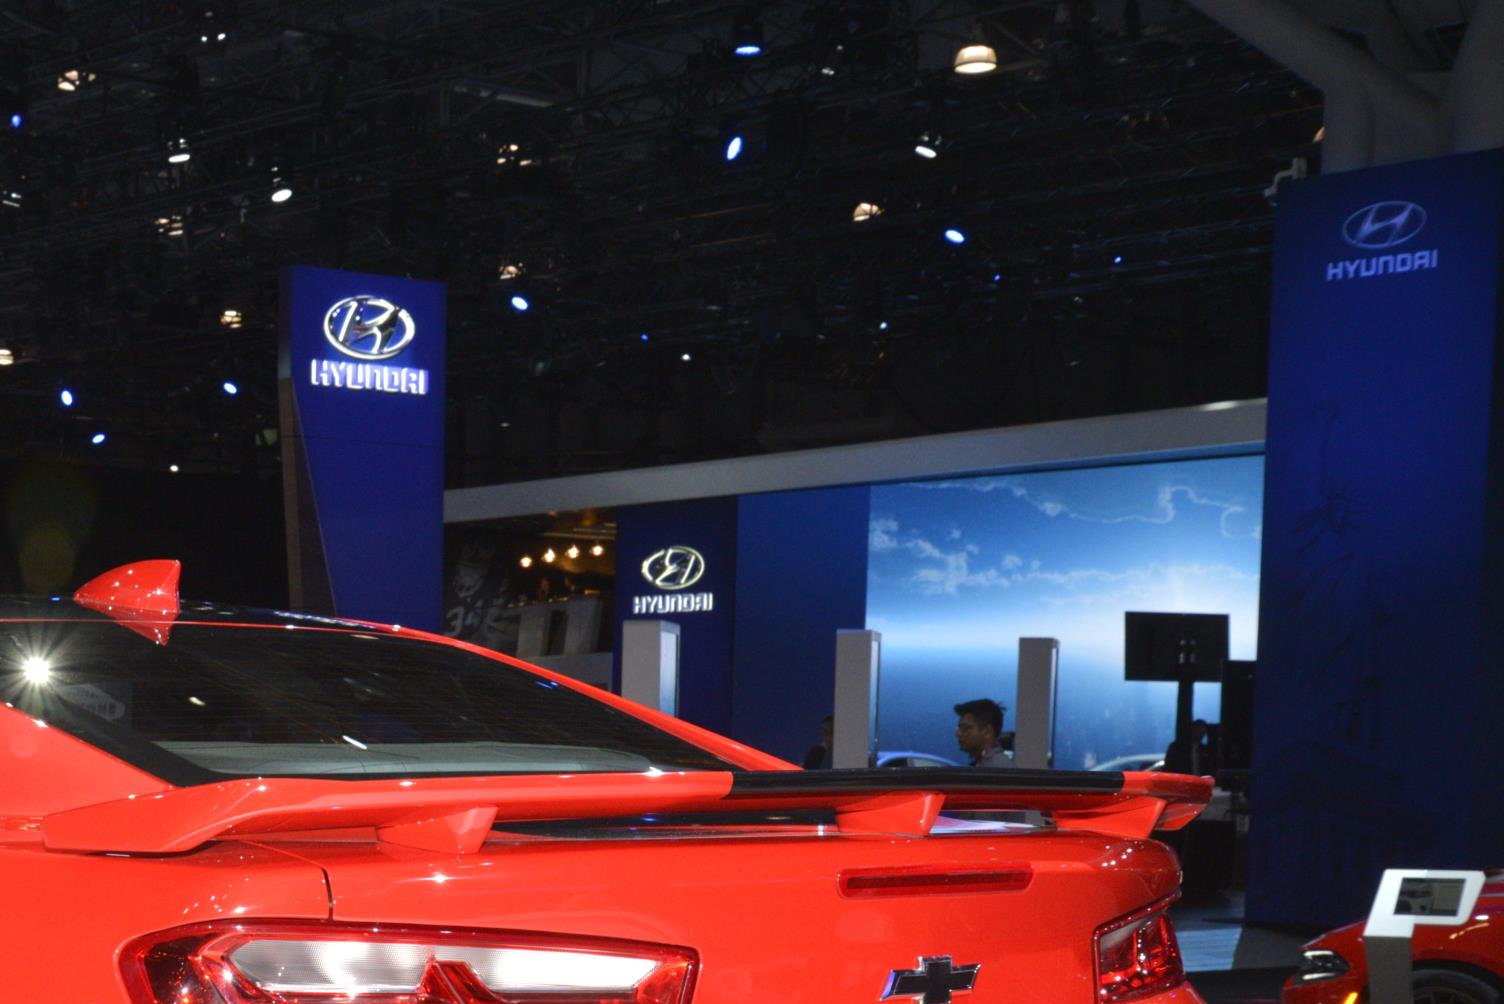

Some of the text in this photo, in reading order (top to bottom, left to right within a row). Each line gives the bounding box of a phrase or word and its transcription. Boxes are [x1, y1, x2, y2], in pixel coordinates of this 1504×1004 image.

[1326, 248, 1439, 281] HYUNDAI
[310, 358, 429, 395] HYUNDAI
[633, 592, 713, 614] HYUNDAI
